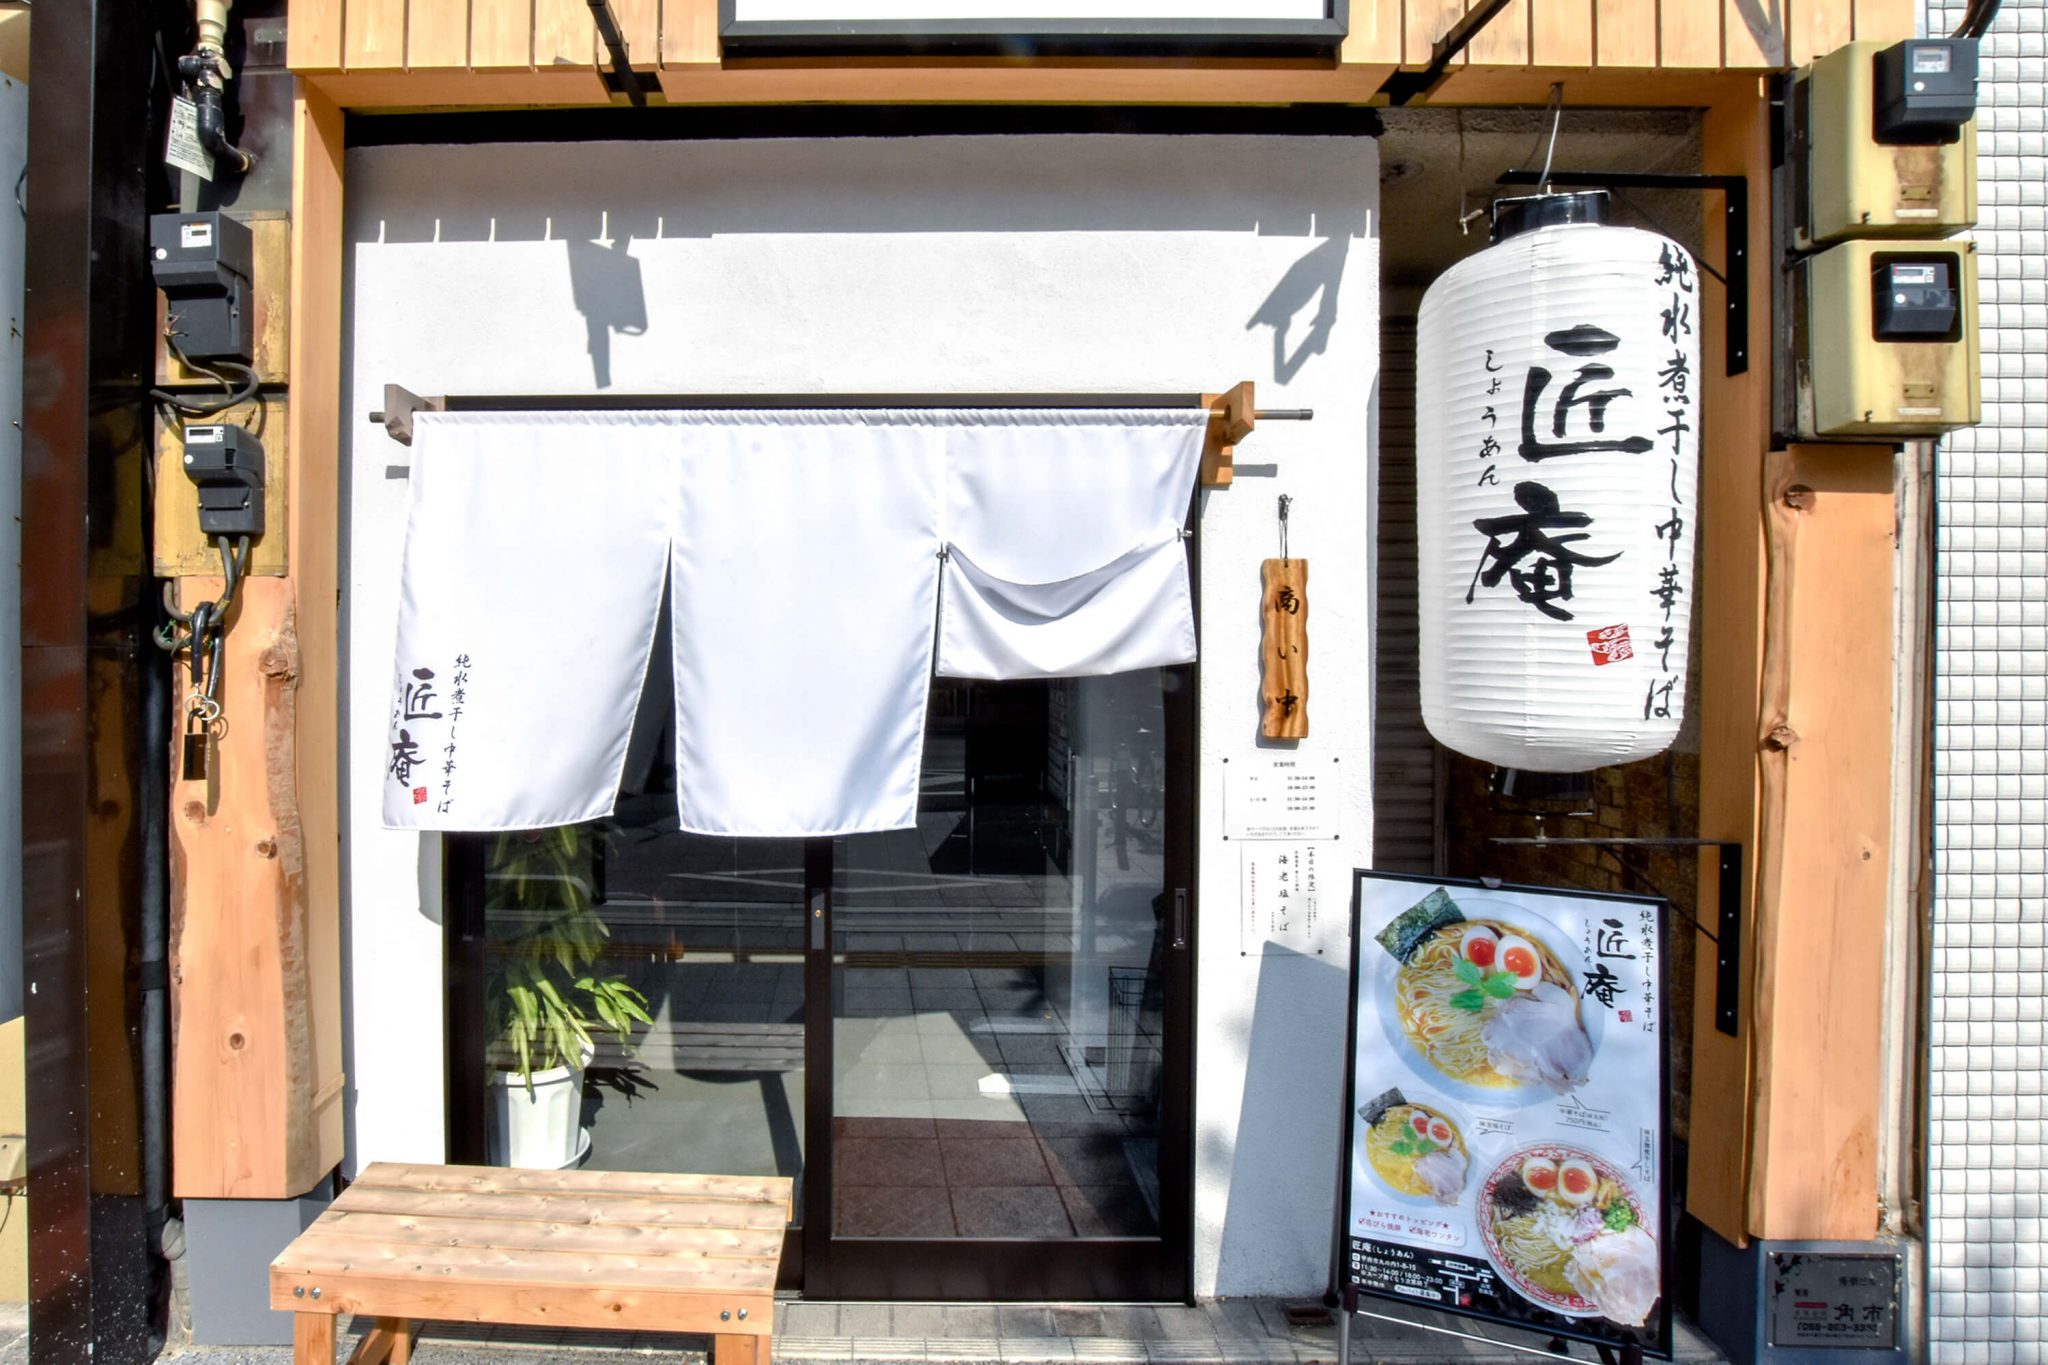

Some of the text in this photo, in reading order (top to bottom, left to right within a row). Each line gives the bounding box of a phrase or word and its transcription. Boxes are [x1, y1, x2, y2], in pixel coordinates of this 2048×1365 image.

[1465, 323, 1654, 622] 匠庵
[1477, 349, 1503, 487] しょうあん
[1643, 242, 1694, 721] 純水煮干し中華そば
[1273, 586, 1300, 719] 商い中
[386, 667, 443, 788] 匠庵
[437, 653, 472, 814] 純水煮干し中華そば
[1581, 918, 1637, 1009] 匠庵
[1639, 909, 1656, 1033] 純水煮干し中華そば
